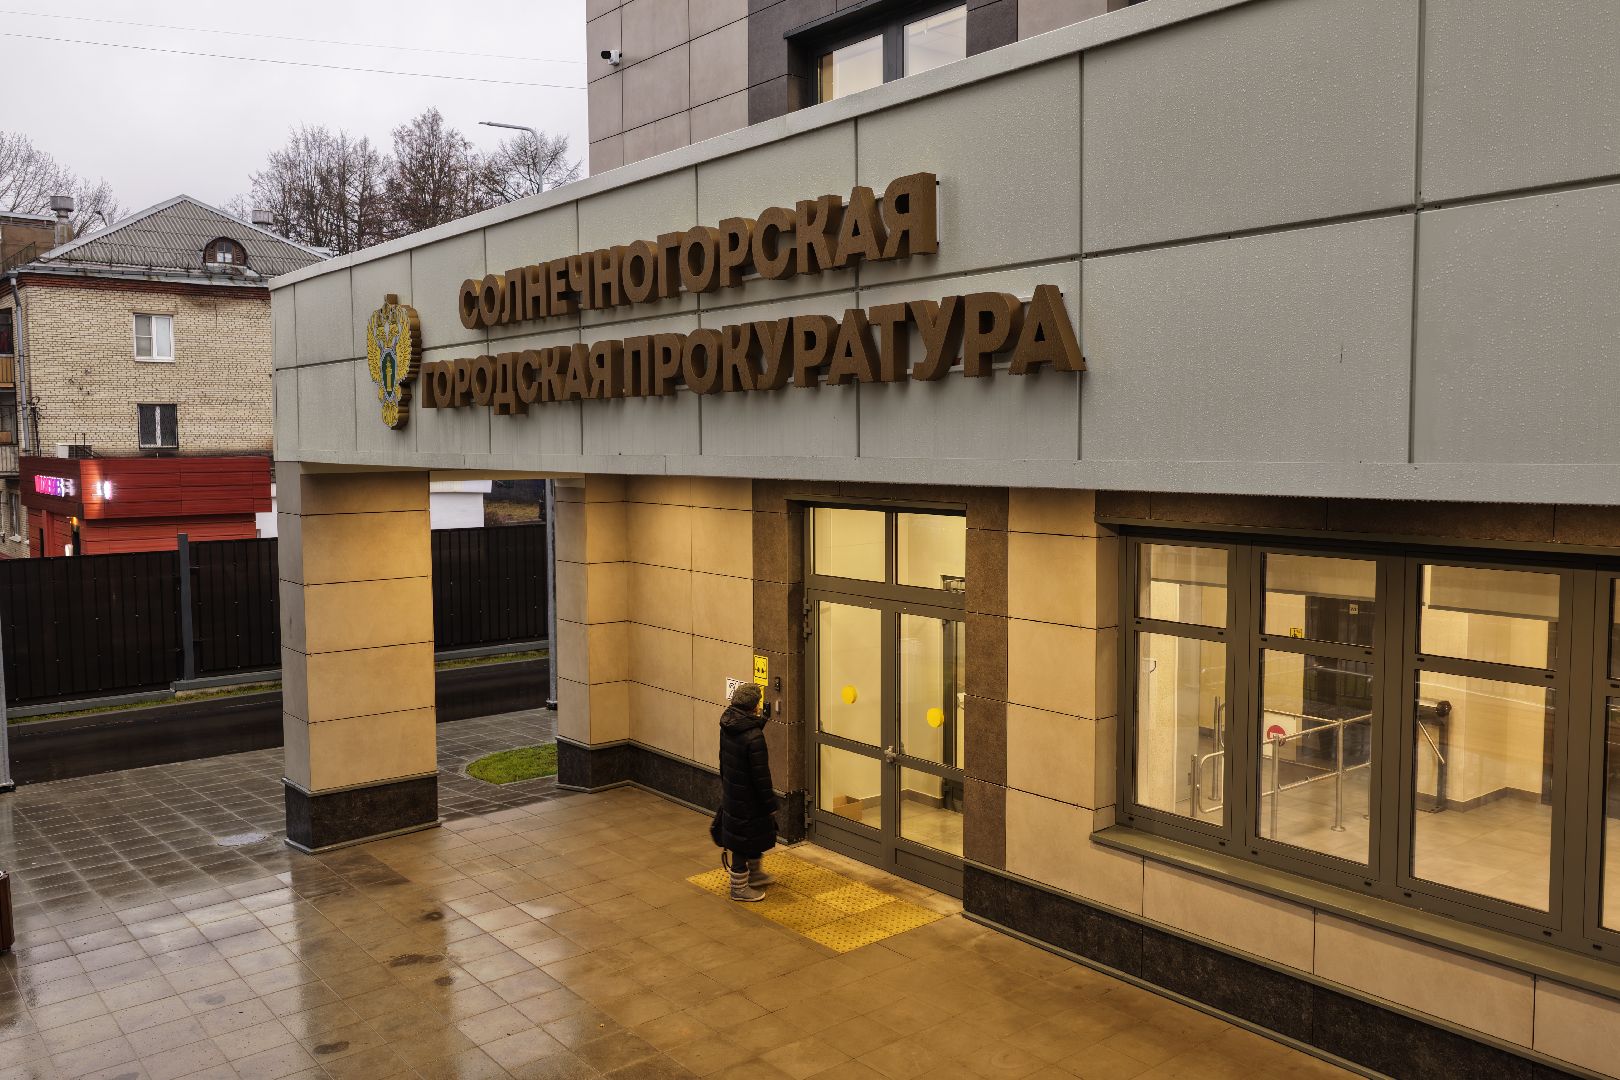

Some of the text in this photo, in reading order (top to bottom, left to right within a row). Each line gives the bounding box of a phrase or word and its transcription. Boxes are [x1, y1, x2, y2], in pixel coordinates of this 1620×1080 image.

[459, 172, 939, 329] СОЛНЕЧНОГОРСКАЯ
[421, 284, 1087, 415] ГОРОДСКАЯ ПРОКУРАТУРА
